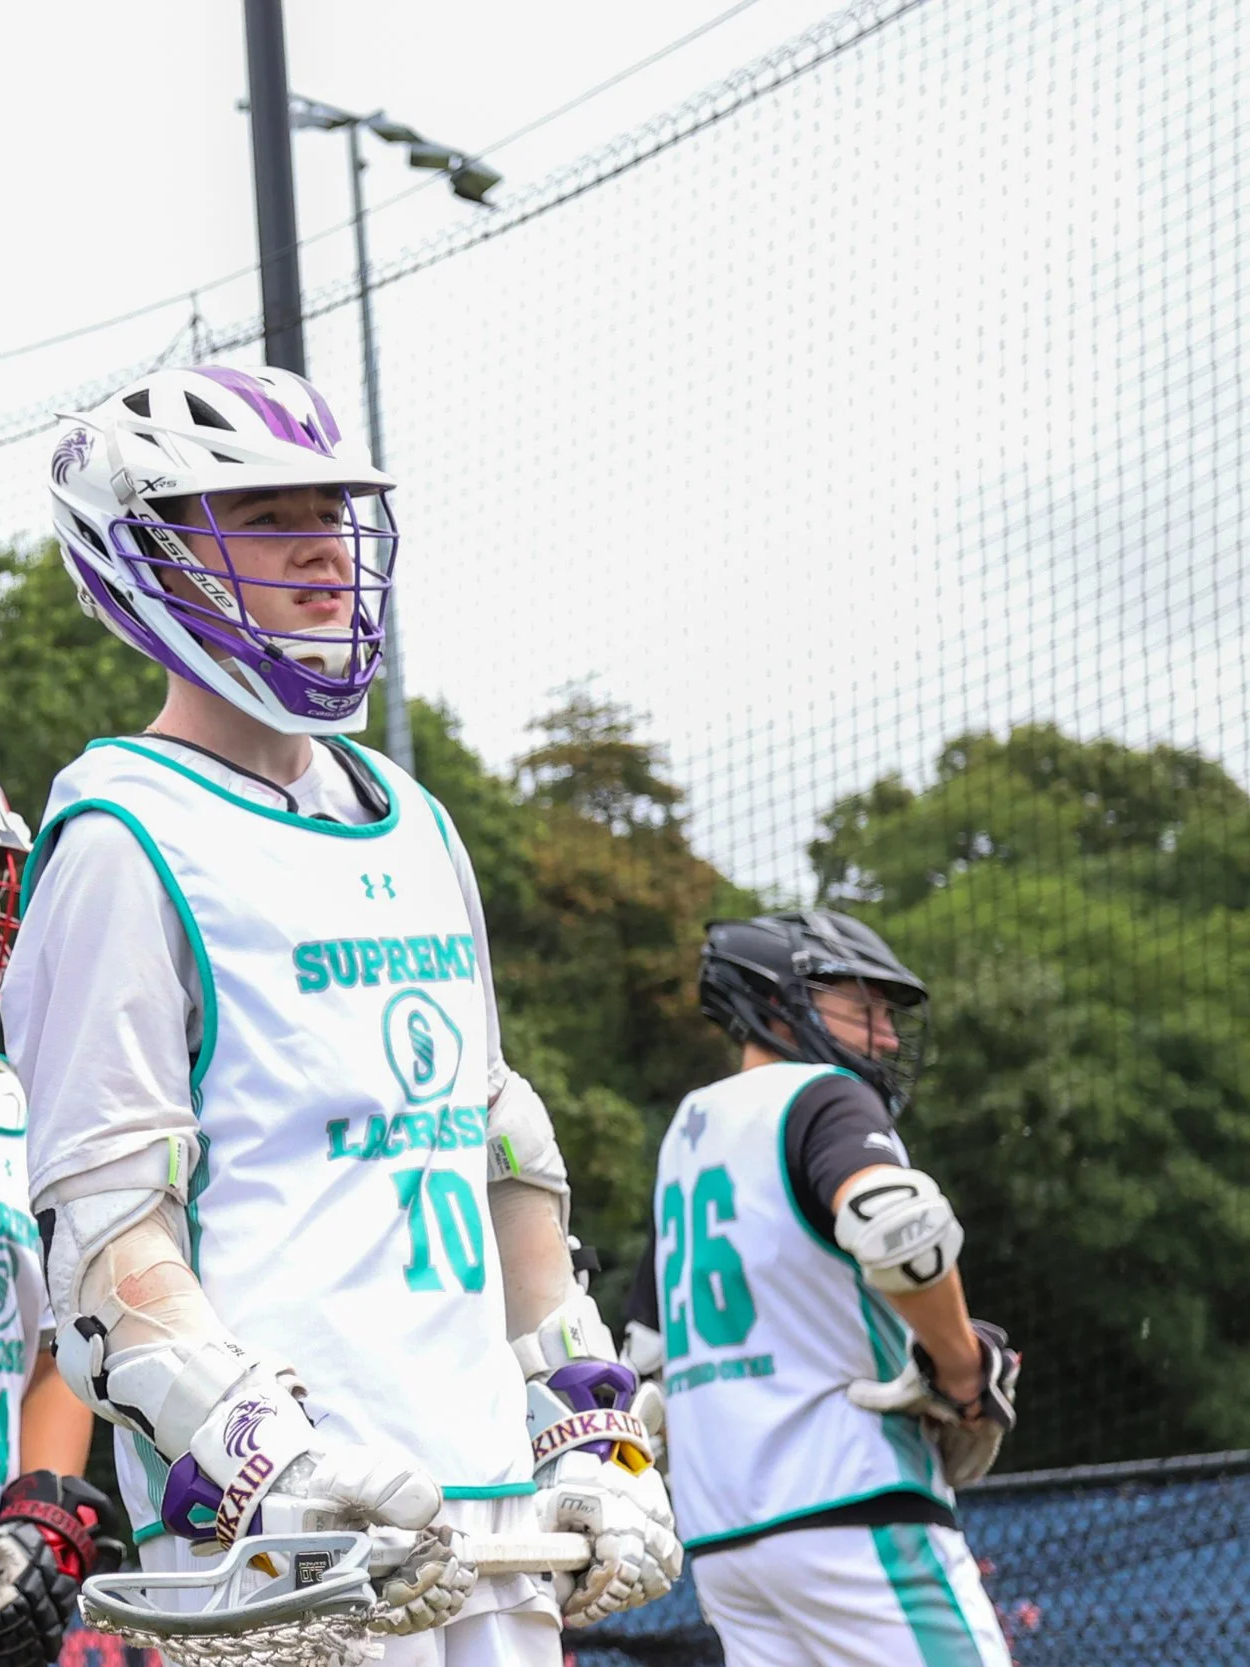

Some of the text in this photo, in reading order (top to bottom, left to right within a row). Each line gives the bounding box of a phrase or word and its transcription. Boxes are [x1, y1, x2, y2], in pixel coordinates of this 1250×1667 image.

[389, 1167, 486, 1293] 10
[660, 1164, 756, 1362] 26
[530, 1411, 643, 1462] KINKAID
[216, 1453, 275, 1552] NKAID
